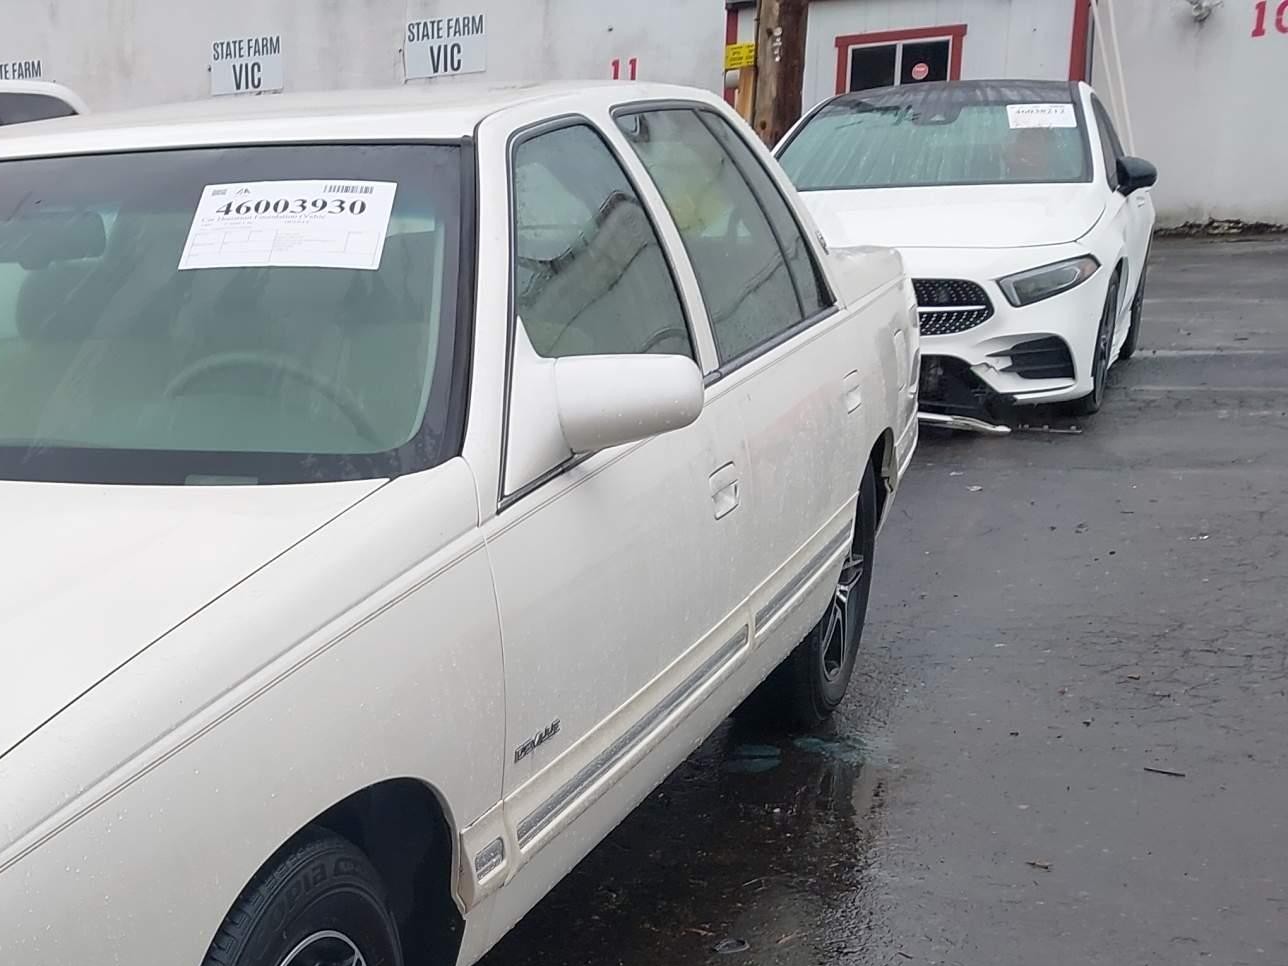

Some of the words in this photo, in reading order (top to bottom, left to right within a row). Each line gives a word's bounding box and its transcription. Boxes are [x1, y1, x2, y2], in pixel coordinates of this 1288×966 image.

[408, 20, 443, 42] STATE
[447, 14, 483, 38] FARM
[213, 40, 244, 61] STATE
[247, 36, 280, 57] FARM
[430, 43, 461, 74] VIC
[12, 60, 41, 79] FARM
[232, 62, 261, 90] VIC
[612, 58, 637, 80] 11
[216, 199, 366, 216] 46003930
